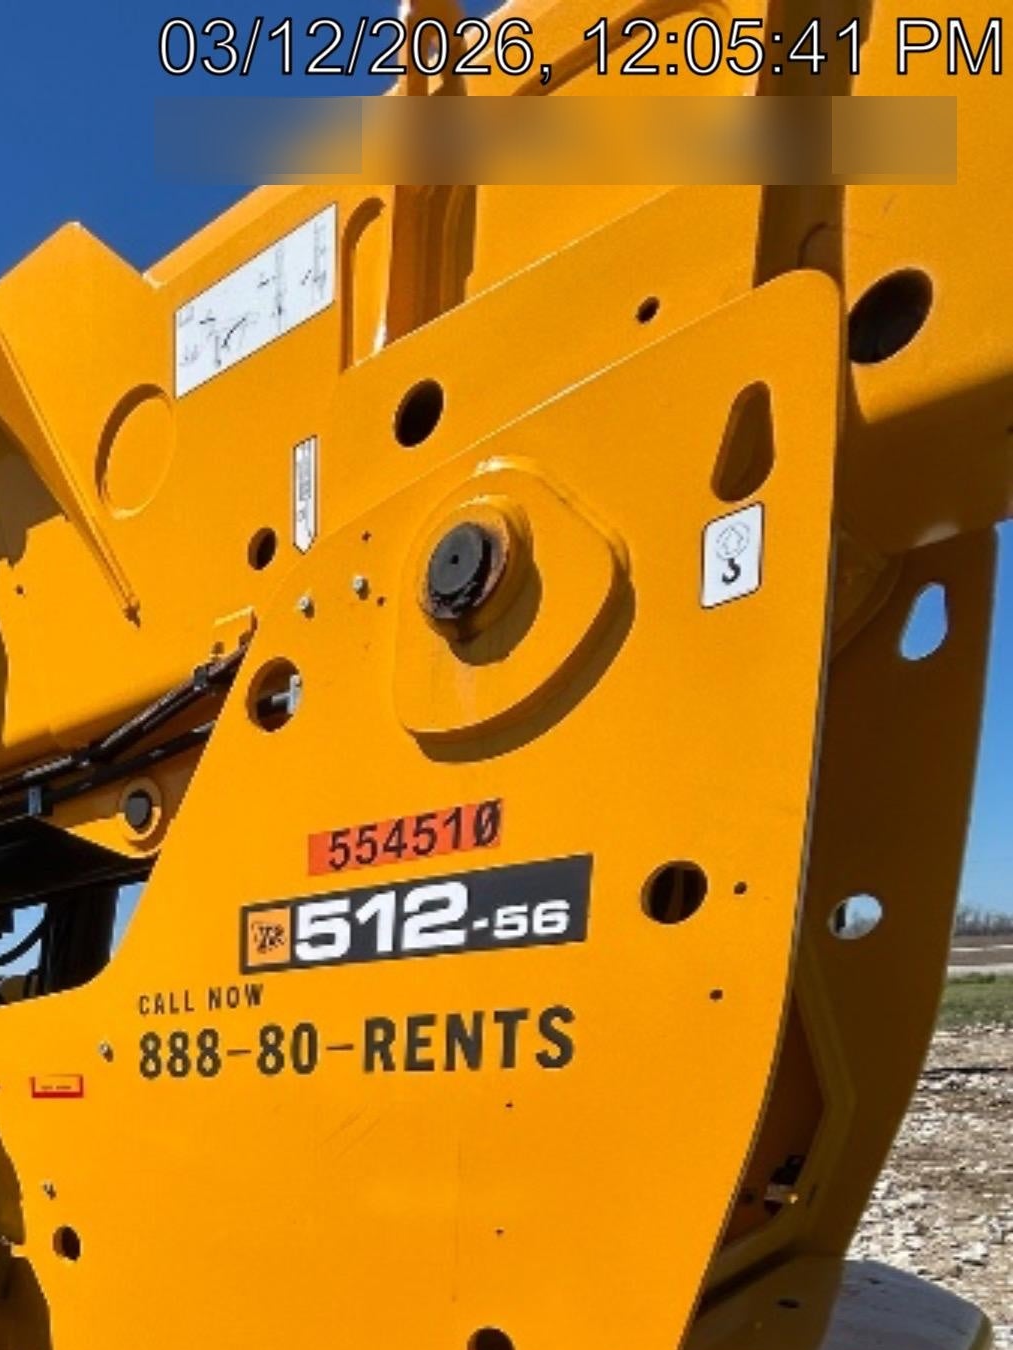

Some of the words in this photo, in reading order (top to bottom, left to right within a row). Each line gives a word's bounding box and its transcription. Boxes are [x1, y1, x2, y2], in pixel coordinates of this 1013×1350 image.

[329, 799, 503, 870] 554510
[295, 881, 570, 962] 512-56
[138, 990, 195, 1016] CALL
[207, 983, 264, 1011] NOW
[138, 1005, 576, 1080] 888-80-RENTS
